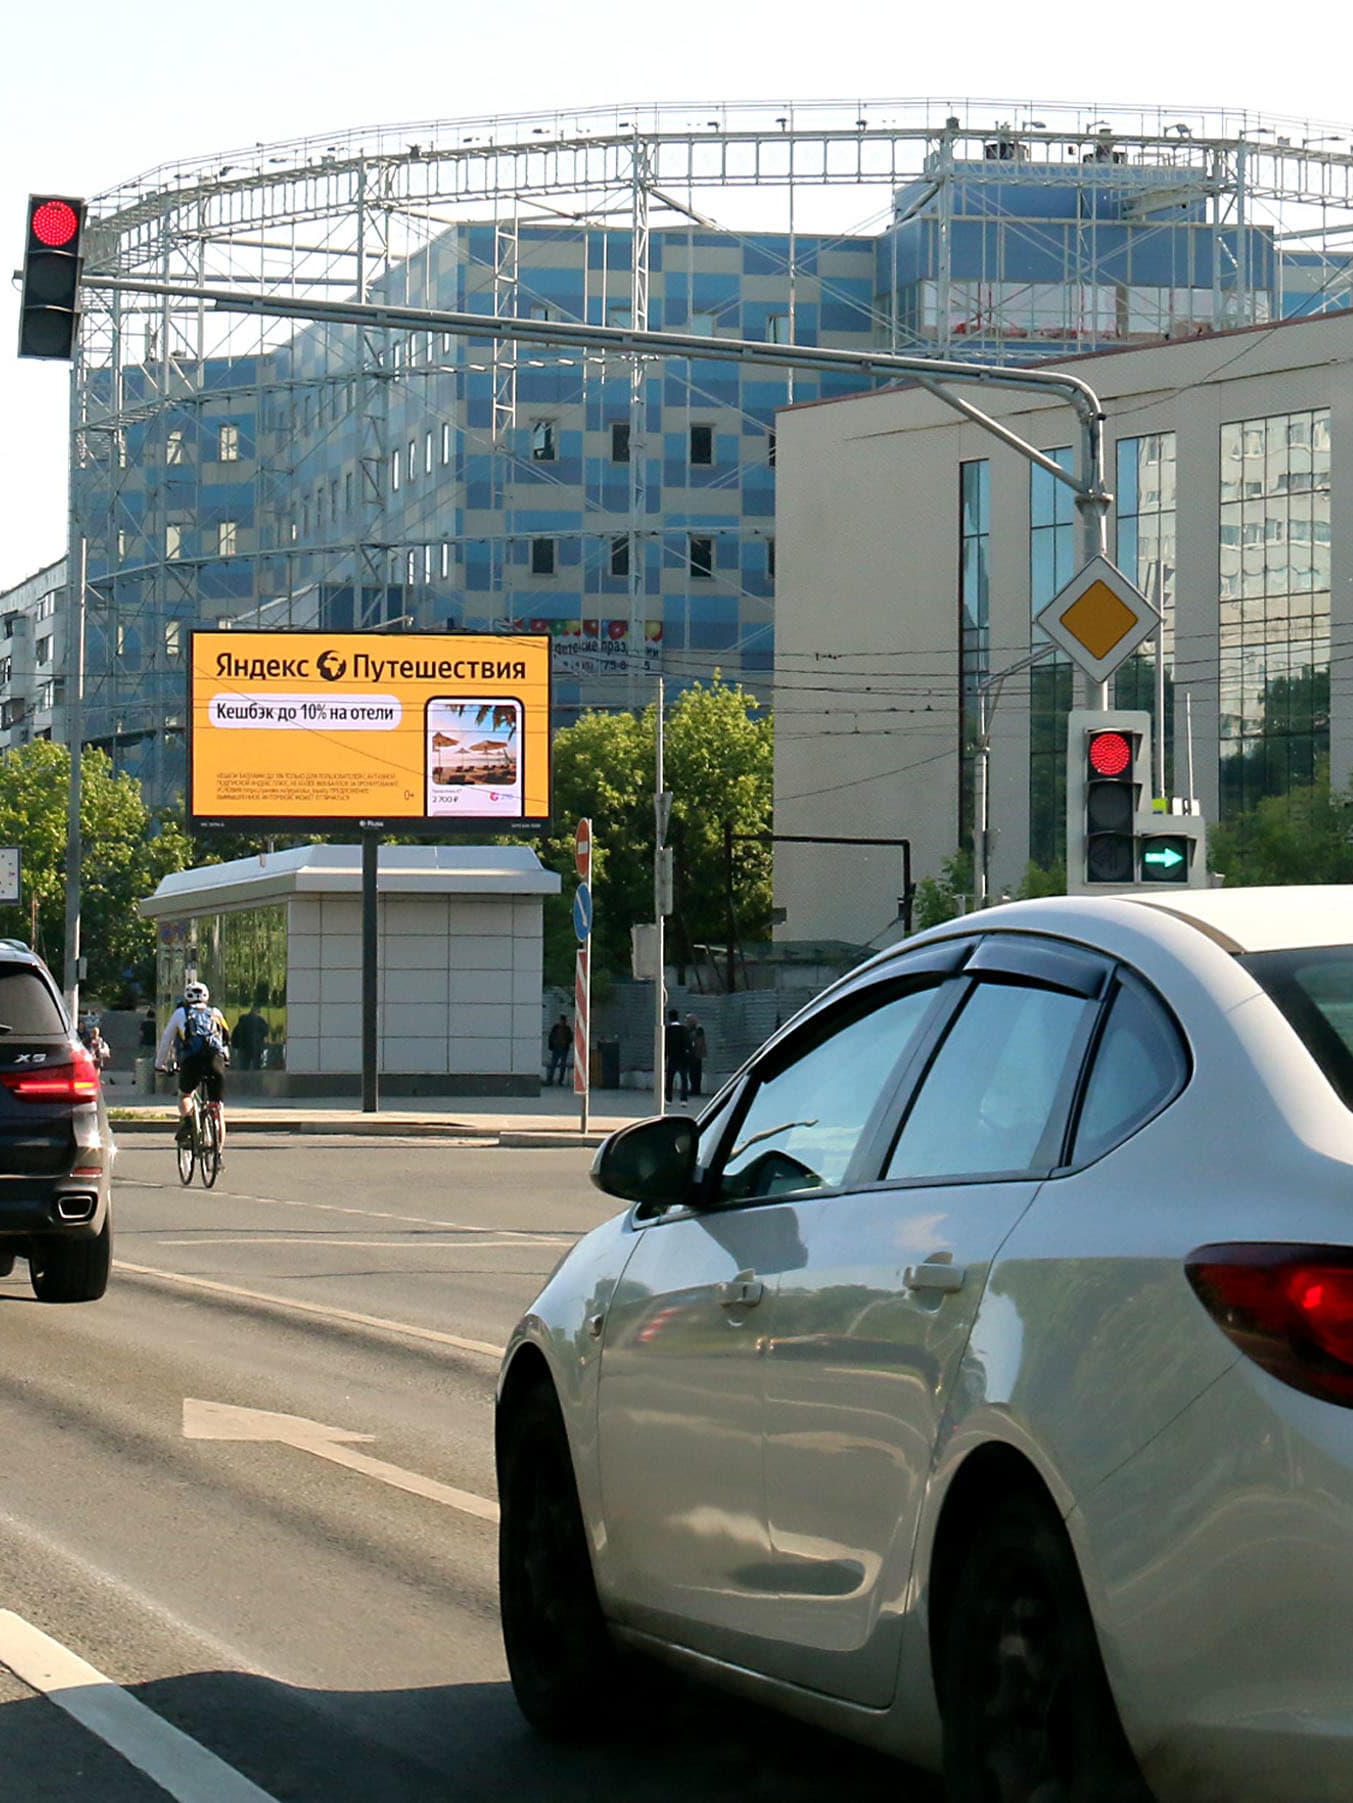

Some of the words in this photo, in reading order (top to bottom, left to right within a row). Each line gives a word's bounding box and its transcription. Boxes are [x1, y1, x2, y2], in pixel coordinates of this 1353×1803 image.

[216, 652, 309, 680] Яндекс
[353, 653, 526, 683] Путешествия
[216, 702, 274, 720] Кешбэк
[277, 710, 297, 722] до
[300, 703, 328, 720] 10%
[330, 709, 347, 721] на
[350, 708, 394, 721] отели
[14, 1053, 47, 1064] X5
